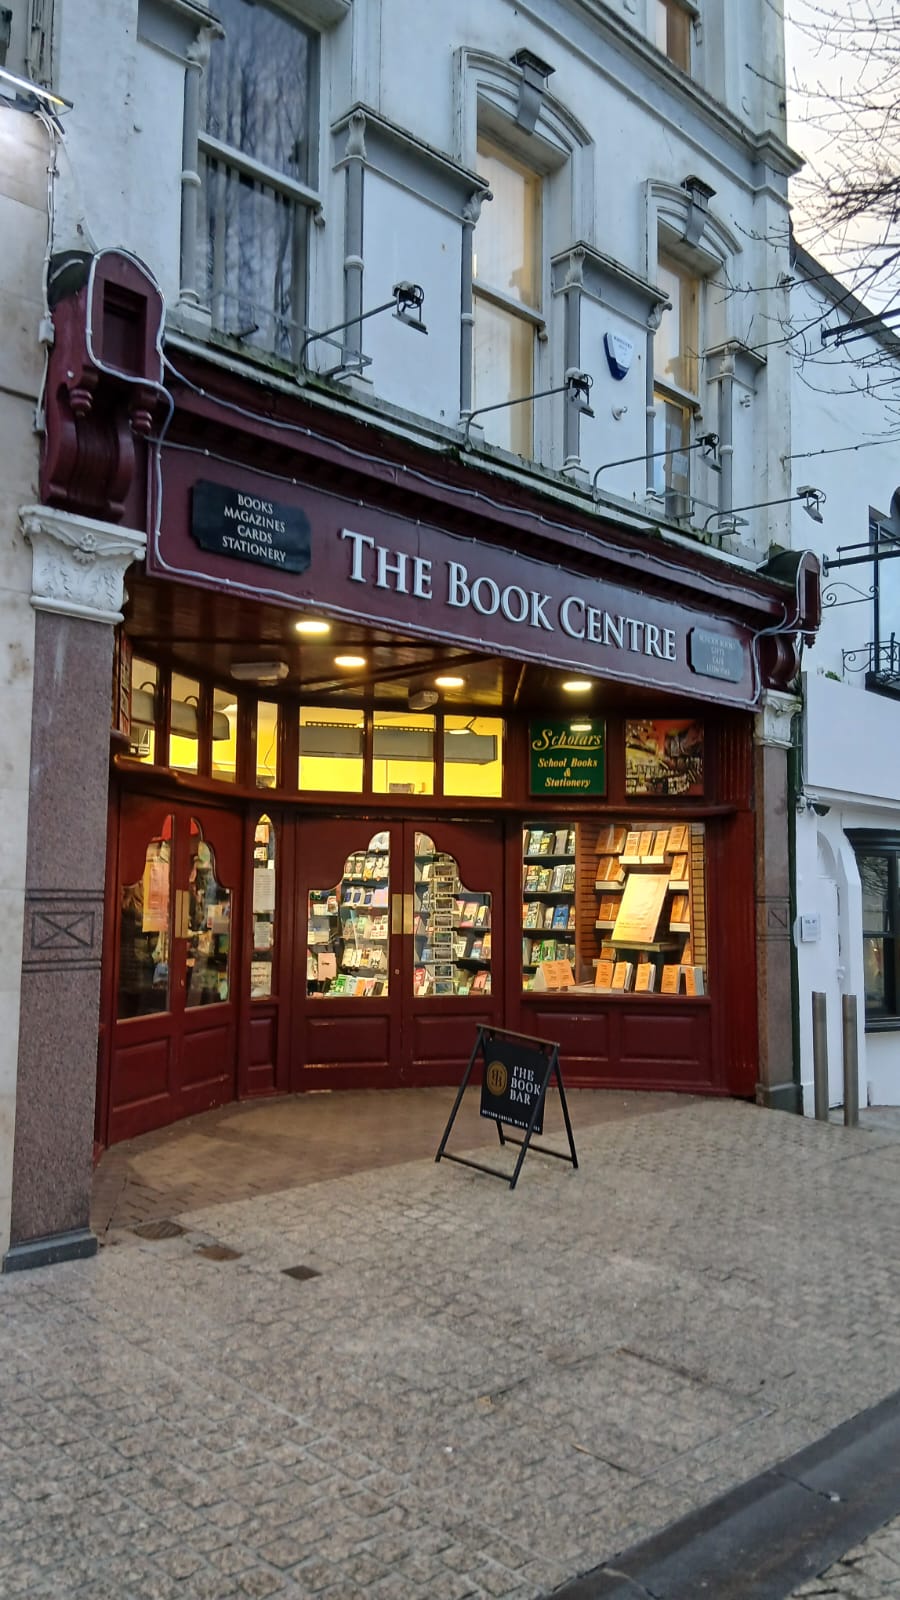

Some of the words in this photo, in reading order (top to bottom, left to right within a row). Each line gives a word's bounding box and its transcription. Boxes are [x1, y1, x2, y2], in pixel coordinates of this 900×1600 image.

[237, 493, 273, 514] BOOKS
[224, 505, 286, 533] MAGAZINES
[237, 524, 273, 544] CARDS
[222, 536, 286, 563] STATIONERY
[341, 528, 433, 600] THE
[446, 561, 555, 631] BOOK
[560, 595, 677, 661] CENTRE
[532, 728, 602, 751] Scholars
[538, 757, 567, 768] School
[571, 757, 598, 768] Books
[563, 767, 571, 777] &
[545, 777, 591, 789] Stationery
[513, 1066, 534, 1081] THE
[510, 1077, 541, 1095] BOOK
[510, 1089, 531, 1105] BAR
